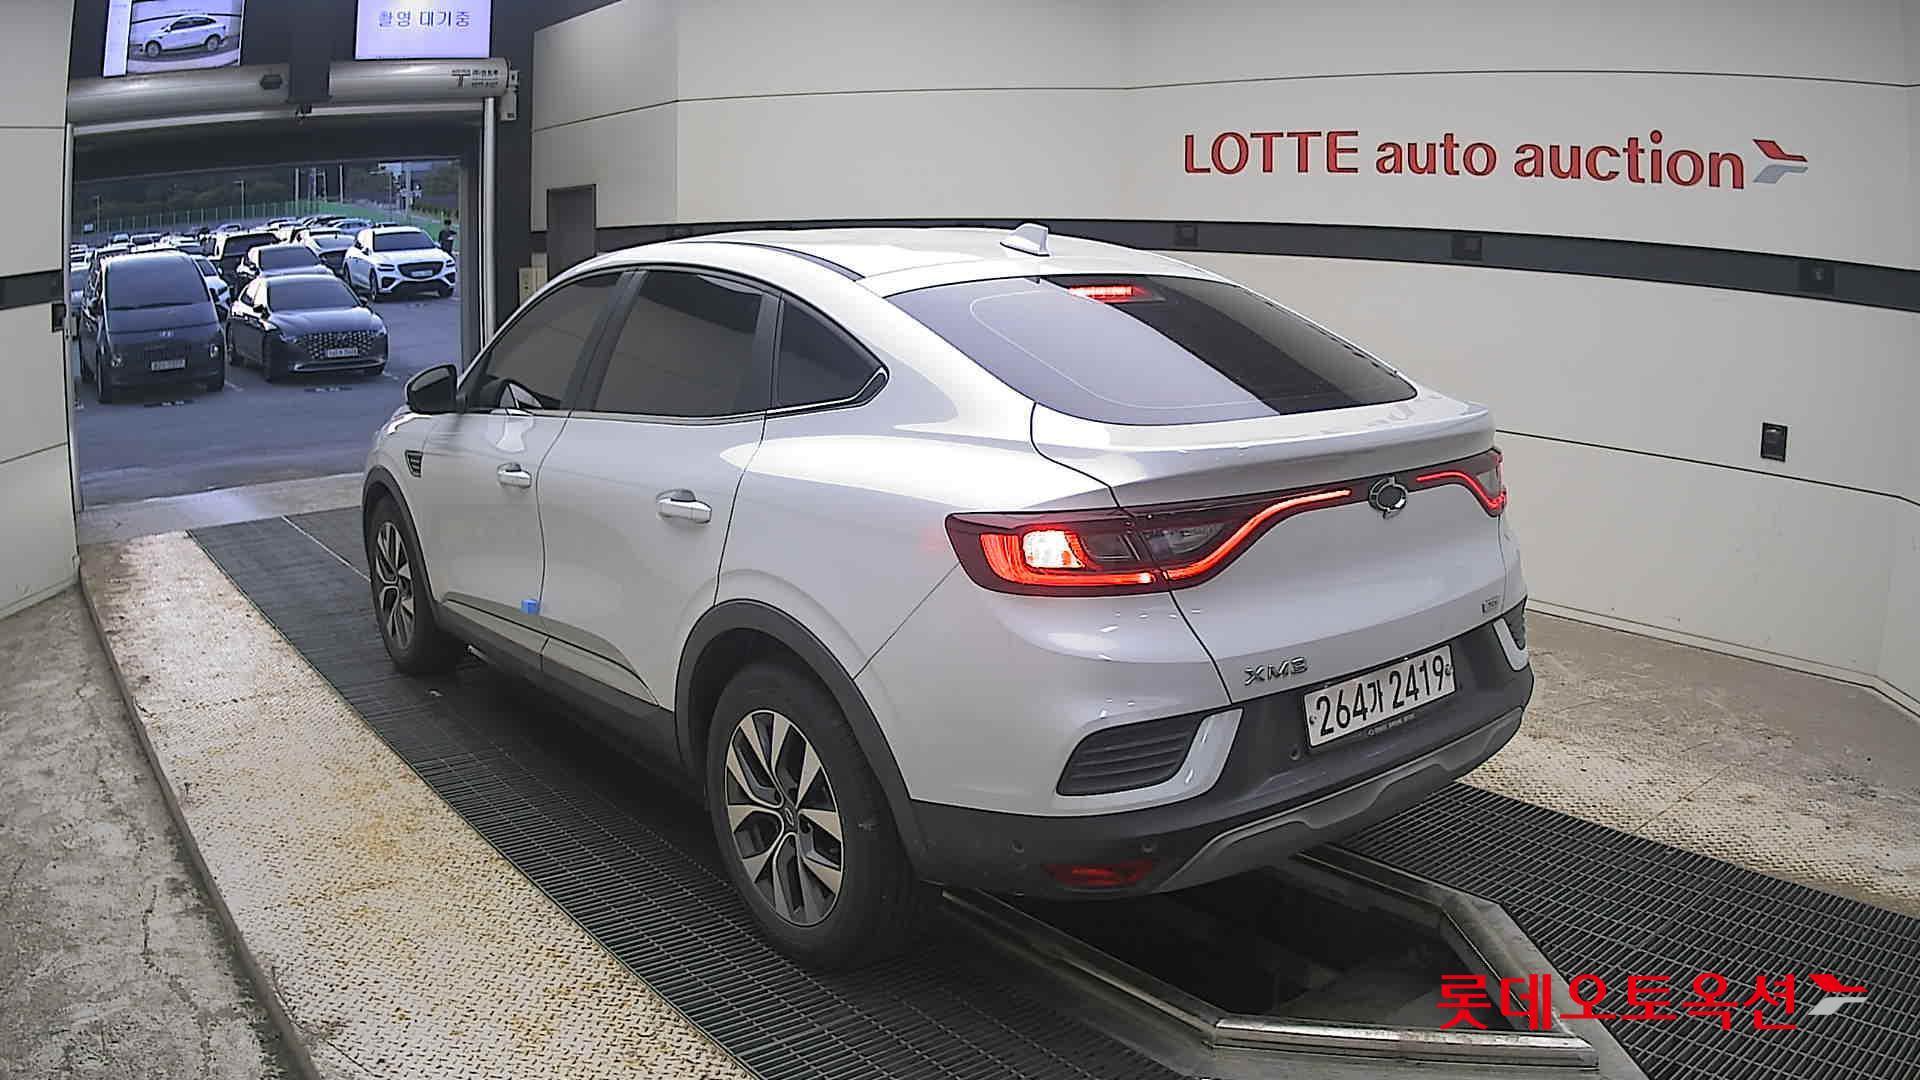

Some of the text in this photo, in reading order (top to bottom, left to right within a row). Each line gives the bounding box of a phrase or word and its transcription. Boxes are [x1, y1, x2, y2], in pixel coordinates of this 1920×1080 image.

[1184, 129, 1745, 189] LOTTE auto auction
[1244, 656, 1308, 687] XM3
[1315, 678, 1384, 736] 264가
[1389, 655, 1444, 710] 2419
